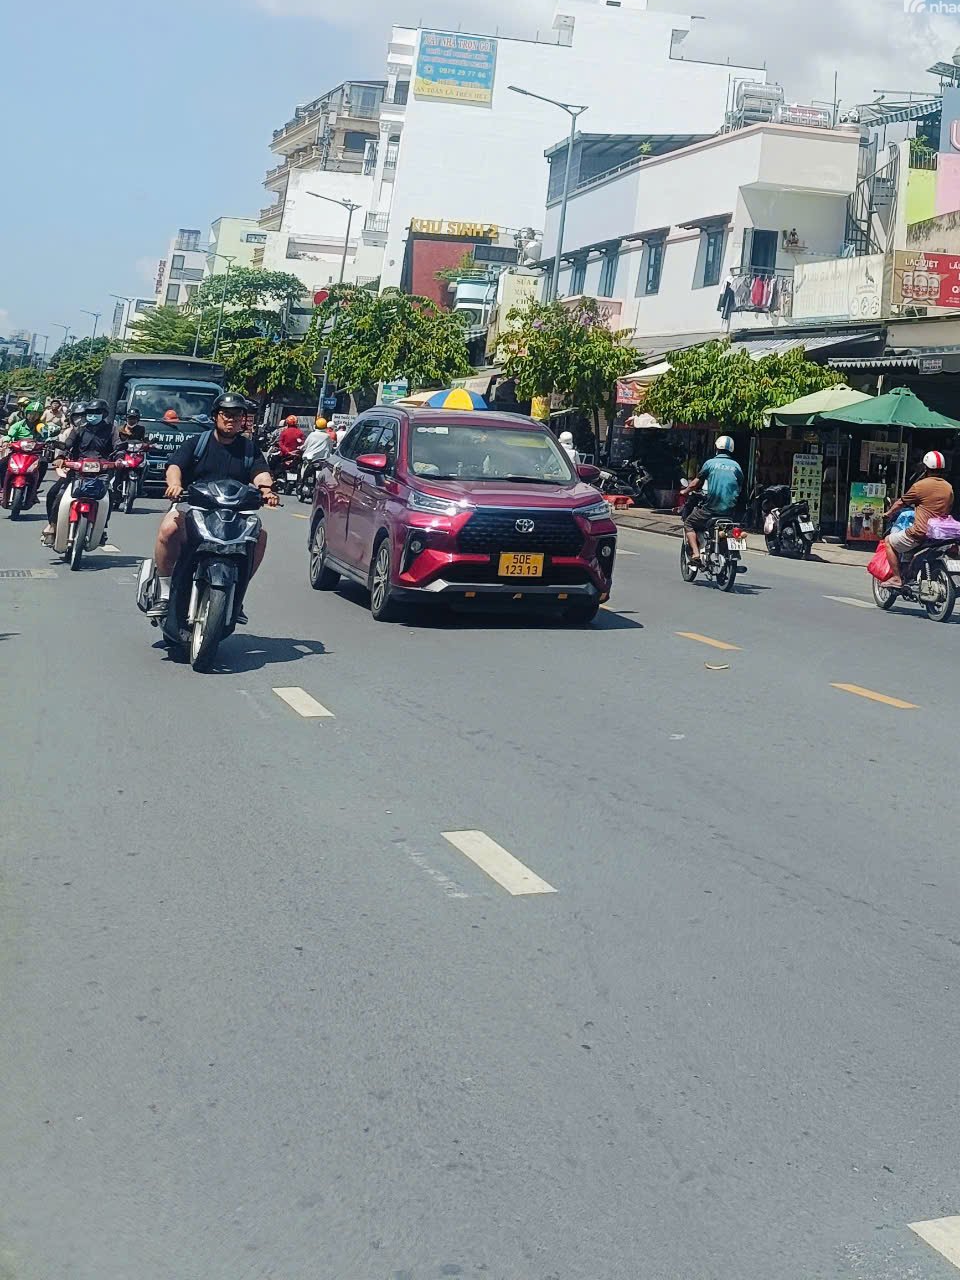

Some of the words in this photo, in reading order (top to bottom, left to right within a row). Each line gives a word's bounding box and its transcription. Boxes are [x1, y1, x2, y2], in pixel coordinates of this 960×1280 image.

[441, 34, 457, 48] NHÀ
[458, 39, 479, 52] TRỌN
[479, 40, 493, 52] GÓI
[447, 222, 485, 237] SINH
[488, 224, 498, 237] 2
[165, 434, 173, 442] TP
[513, 554, 532, 564] 50E
[505, 565, 538, 575] 123.13
